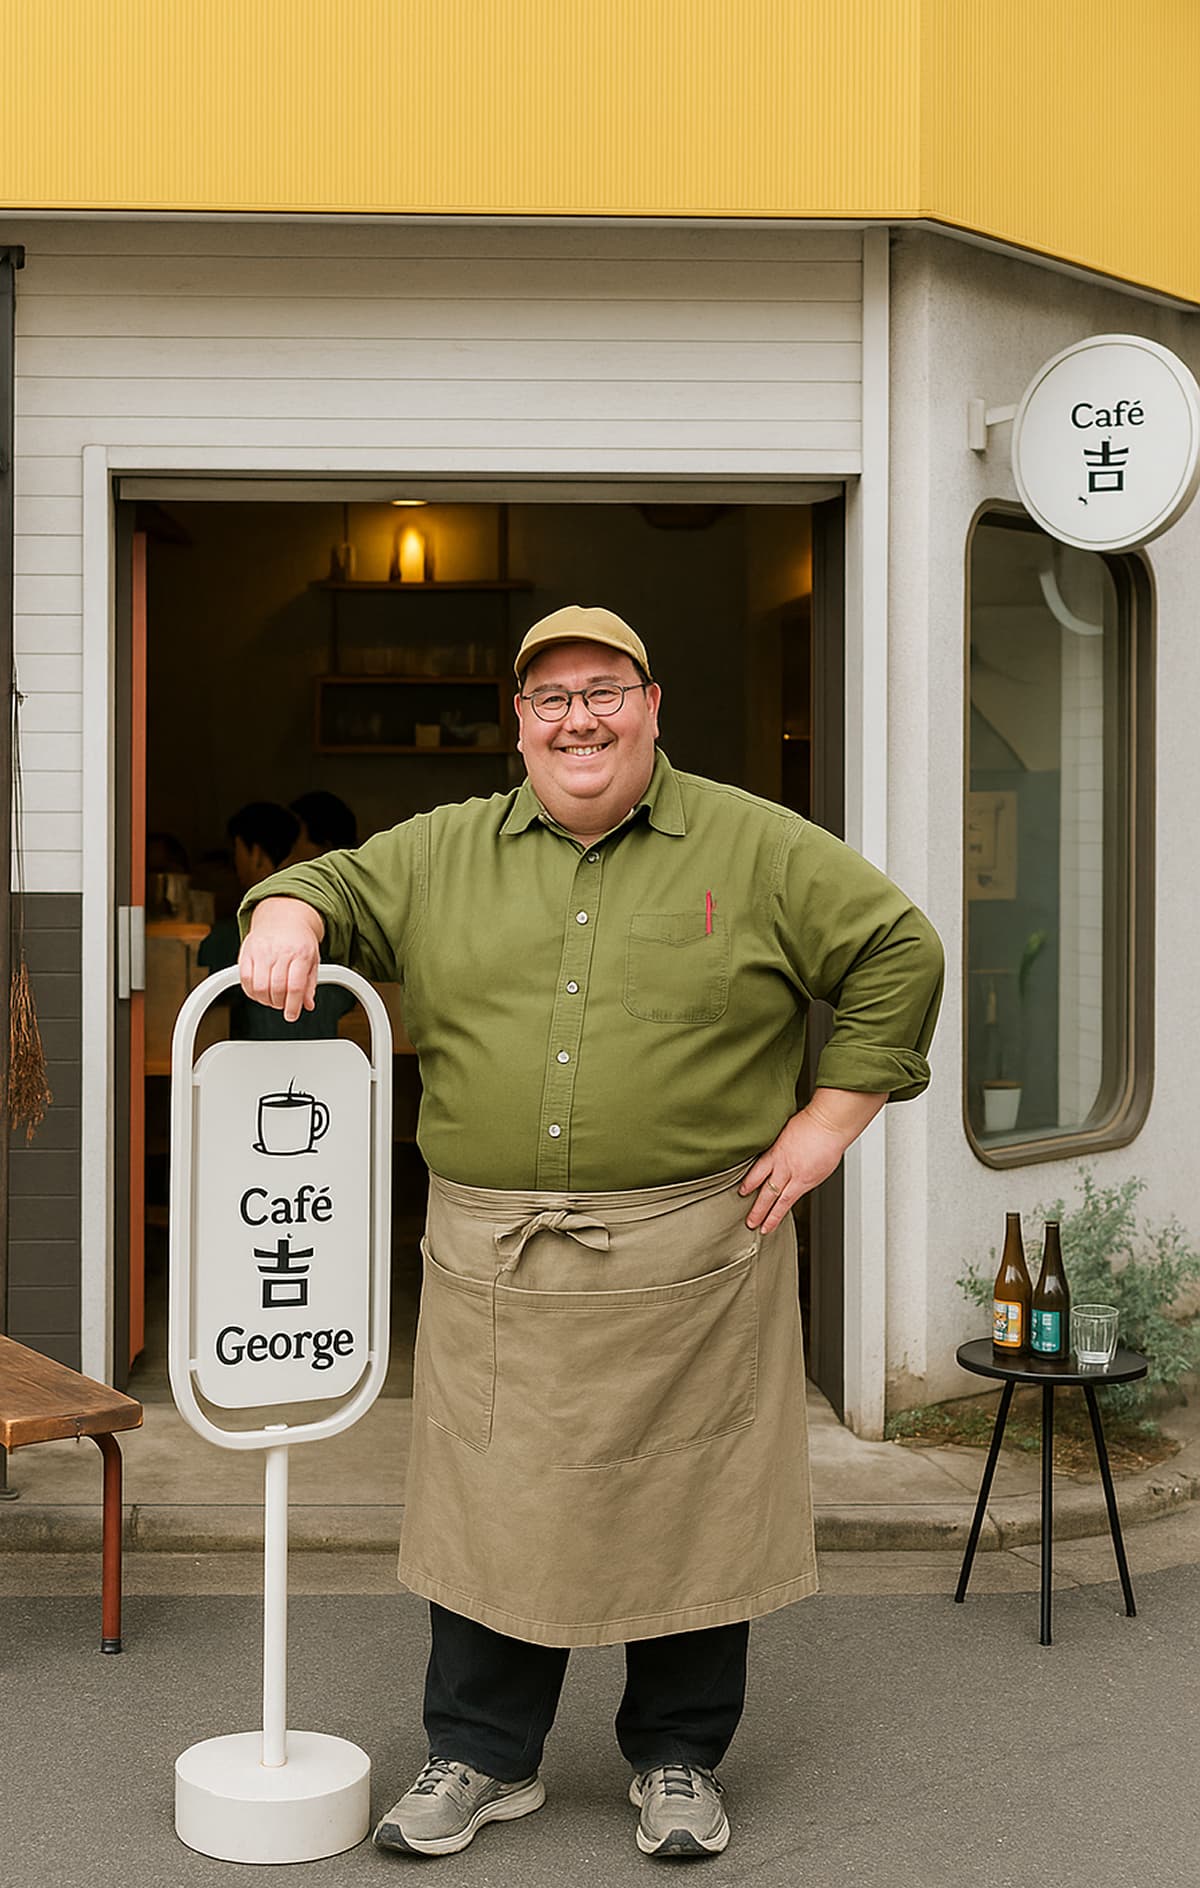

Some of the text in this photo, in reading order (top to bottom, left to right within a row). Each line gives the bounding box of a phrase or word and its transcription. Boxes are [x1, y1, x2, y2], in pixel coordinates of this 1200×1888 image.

[1072, 401, 1144, 428] Café
[1084, 441, 1128, 492] 吉
[241, 1185, 332, 1225] Café
[254, 1240, 313, 1308] 吉
[216, 1327, 353, 1370] George
